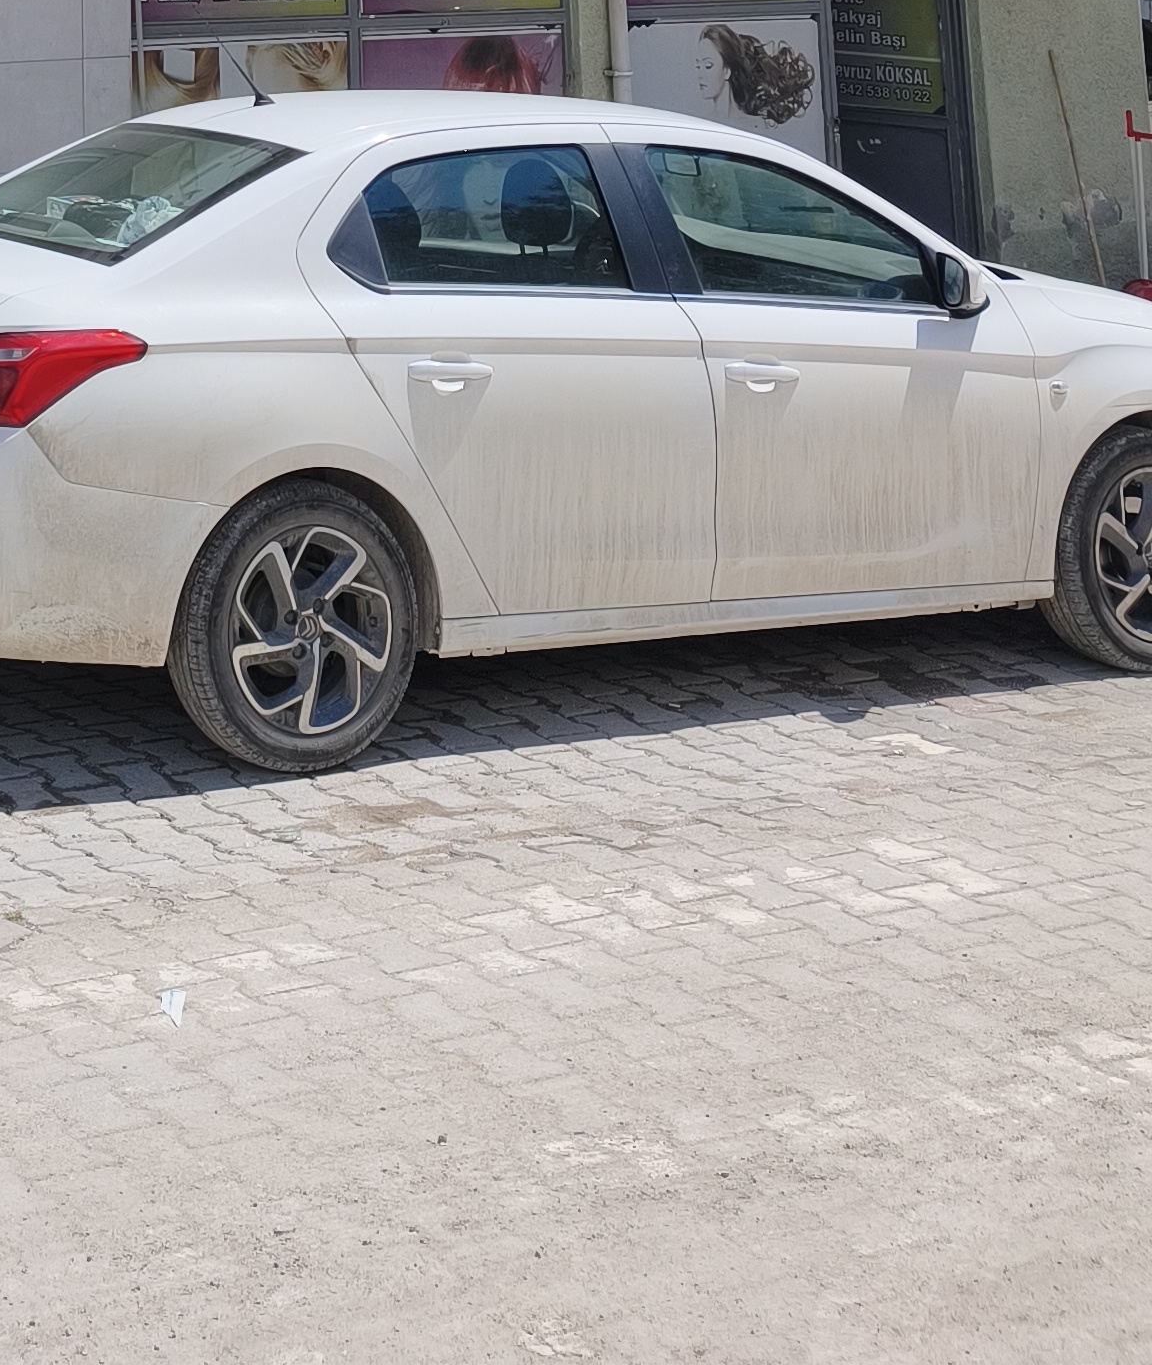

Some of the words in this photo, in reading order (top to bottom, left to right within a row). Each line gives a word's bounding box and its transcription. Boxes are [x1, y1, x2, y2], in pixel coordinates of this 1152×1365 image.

[836, 29, 865, 44] elin
[871, 31, 906, 50] Başı
[836, 65, 871, 80] evruz
[876, 62, 932, 86] KÖKSAL
[840, 83, 863, 96] 542
[867, 85, 889, 98] 538
[895, 88, 910, 101] 10
[914, 90, 930, 103] 22
